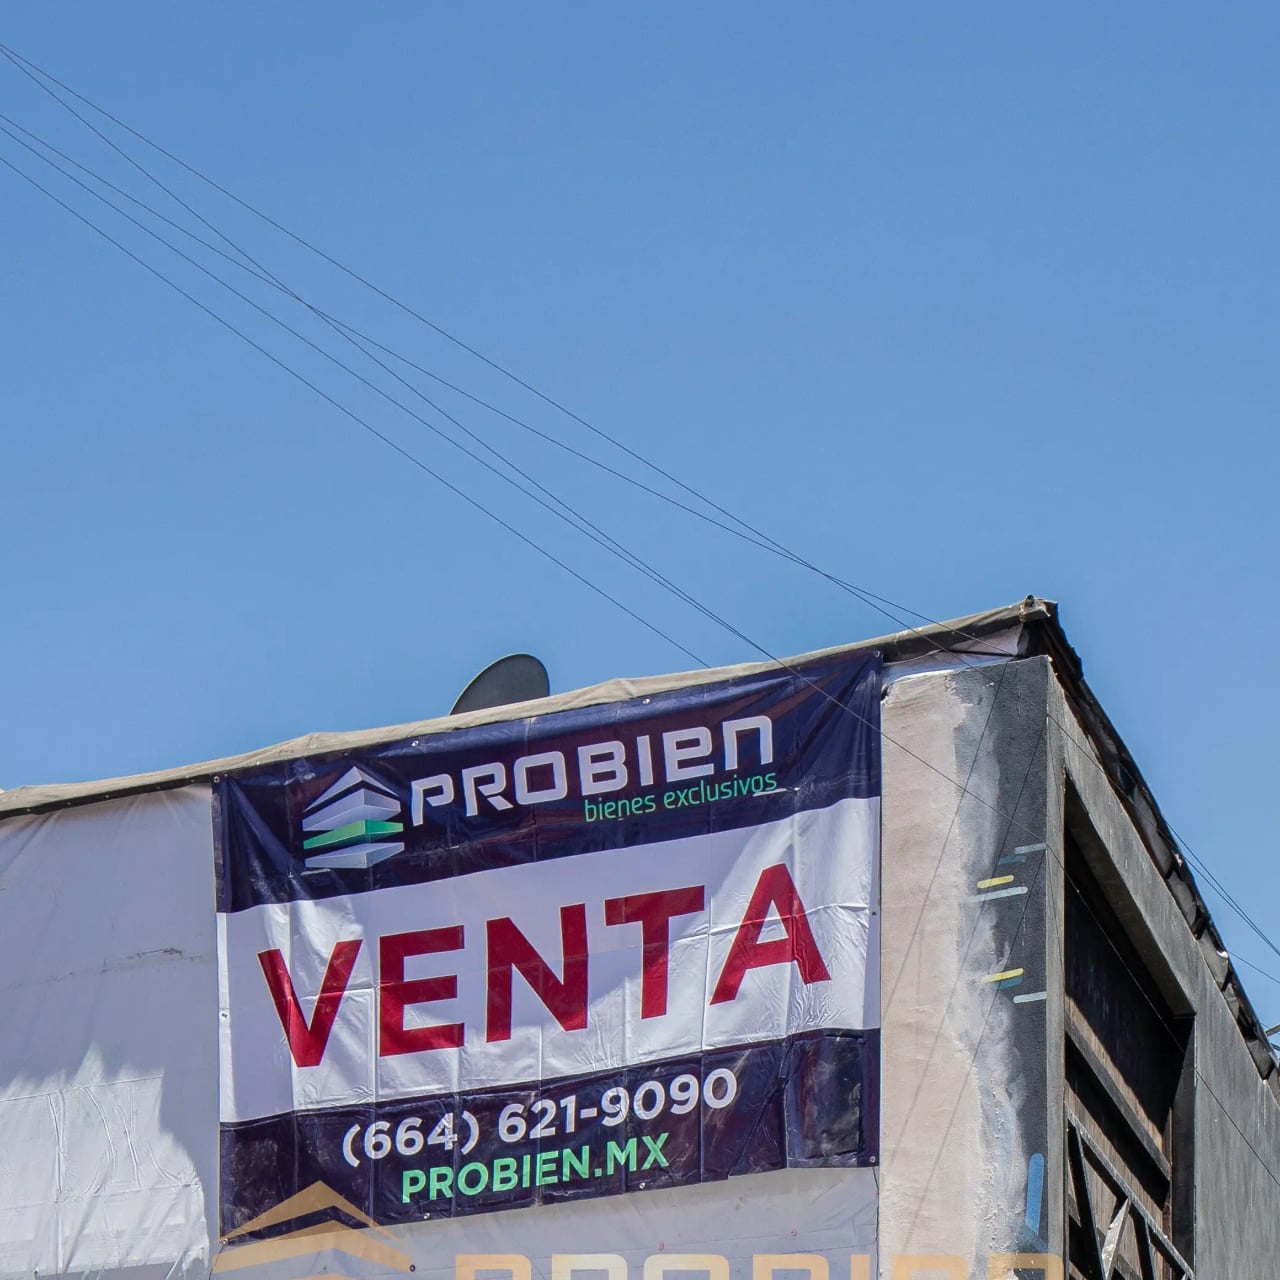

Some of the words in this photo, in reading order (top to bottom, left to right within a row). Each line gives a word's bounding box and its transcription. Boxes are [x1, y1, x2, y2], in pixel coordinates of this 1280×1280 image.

[584, 789, 656, 823] bienes
[663, 771, 778, 810] exclusivos
[257, 862, 832, 1069] VENTA
[341, 1110, 480, 1169] (664)
[497, 1067, 738, 1145] 621-9090
[400, 1131, 671, 1204] PROBIEN.MX
